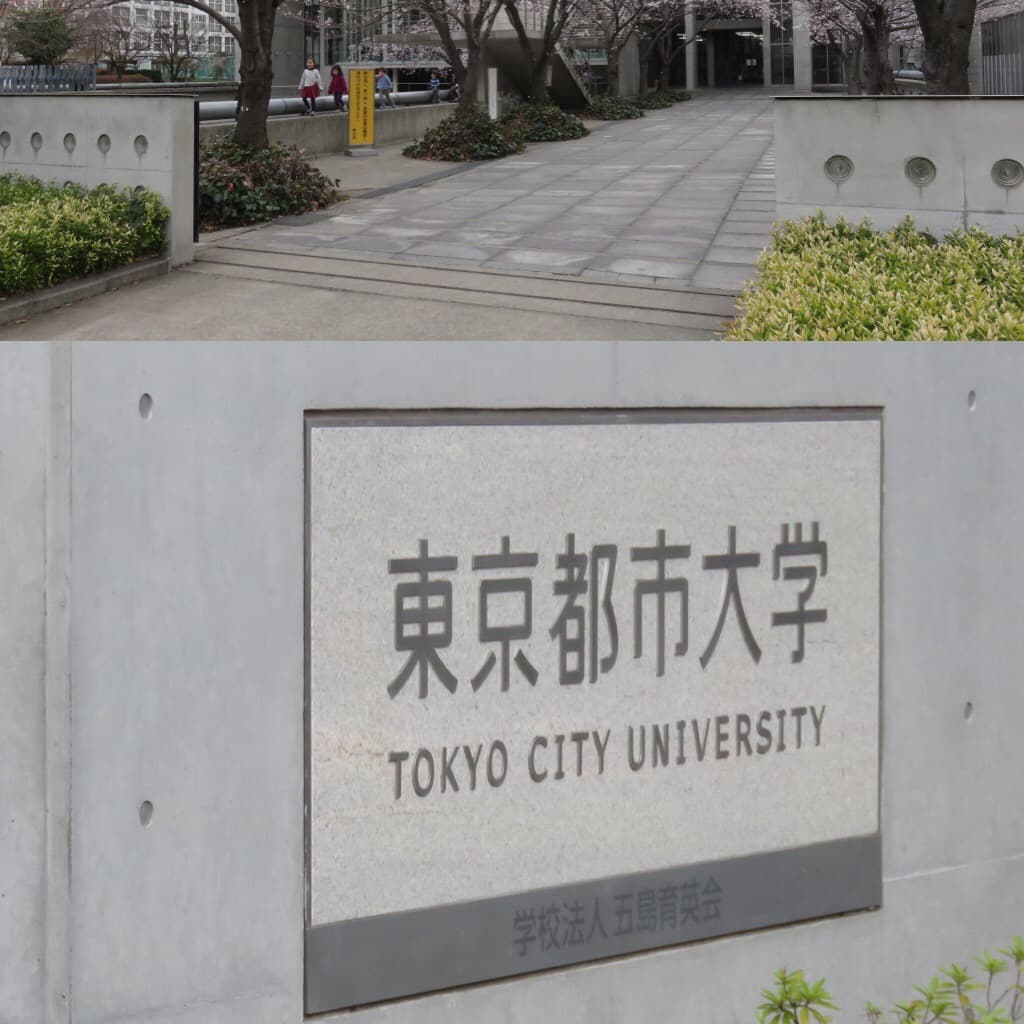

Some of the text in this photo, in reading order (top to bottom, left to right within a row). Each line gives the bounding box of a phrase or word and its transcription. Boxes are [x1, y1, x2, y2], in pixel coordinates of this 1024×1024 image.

[387, 521, 828, 699] 東京都市大学
[387, 705, 827, 800] TOKYO CITY UNIVERSITY
